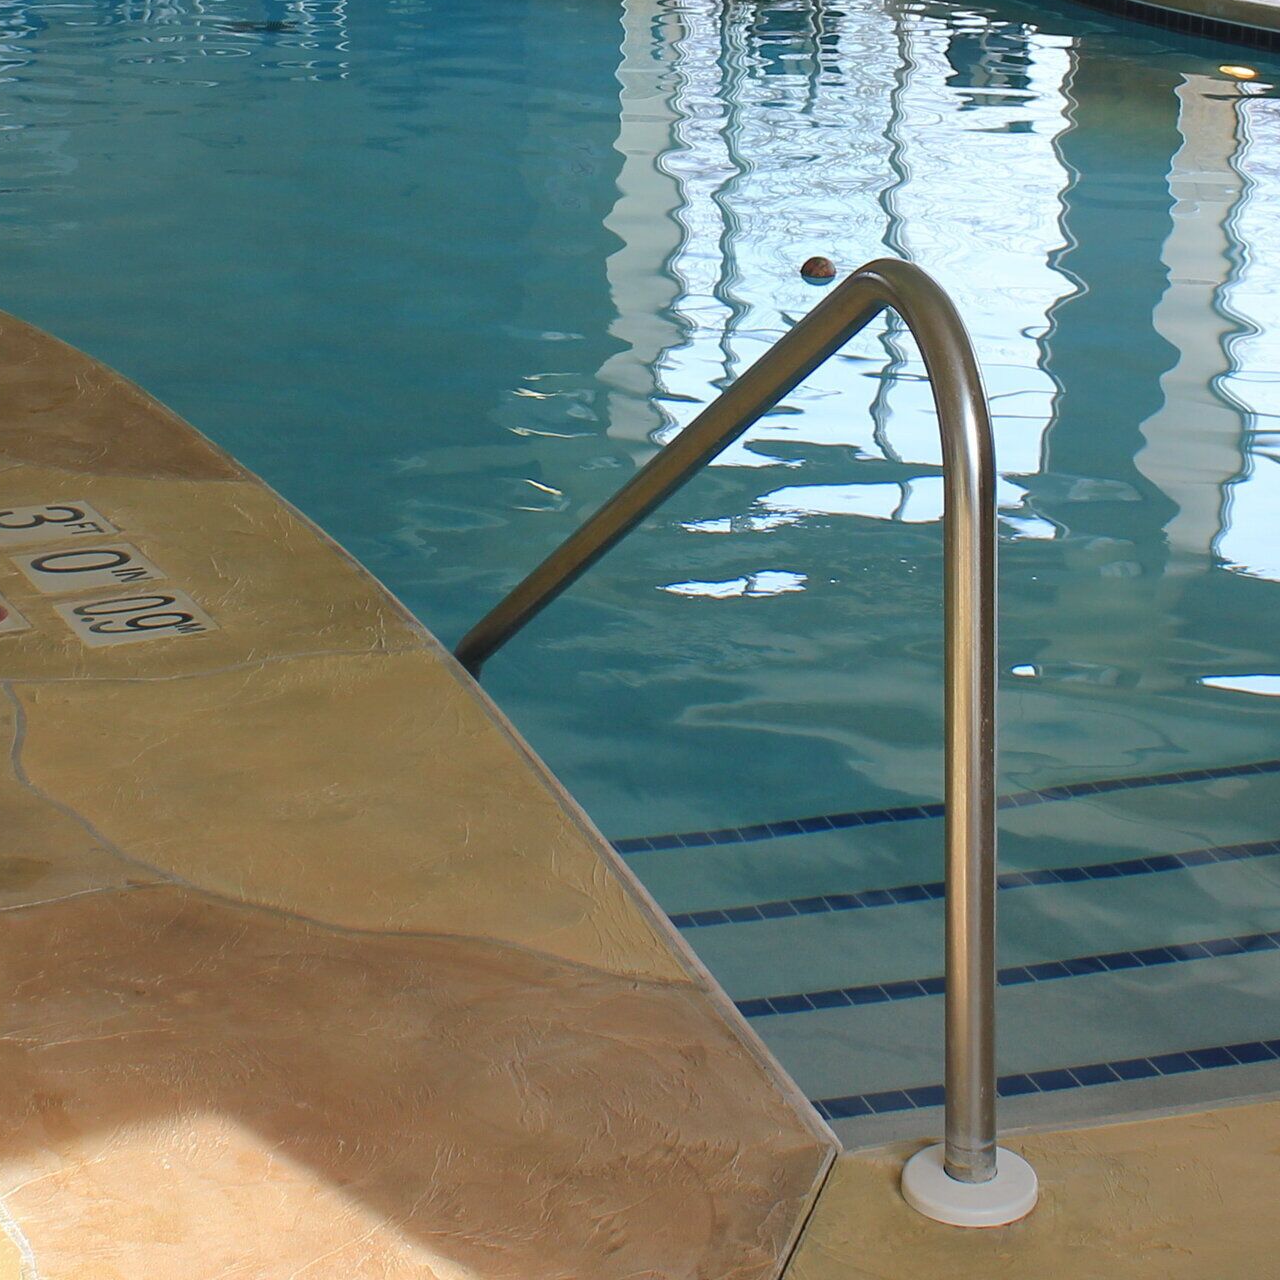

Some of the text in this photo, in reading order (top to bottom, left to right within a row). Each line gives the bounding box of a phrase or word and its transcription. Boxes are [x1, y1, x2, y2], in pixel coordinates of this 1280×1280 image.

[64, 521, 105, 535] FT
[30, 549, 153, 583] 0 IN
[73, 595, 207, 635] 0.9 M
